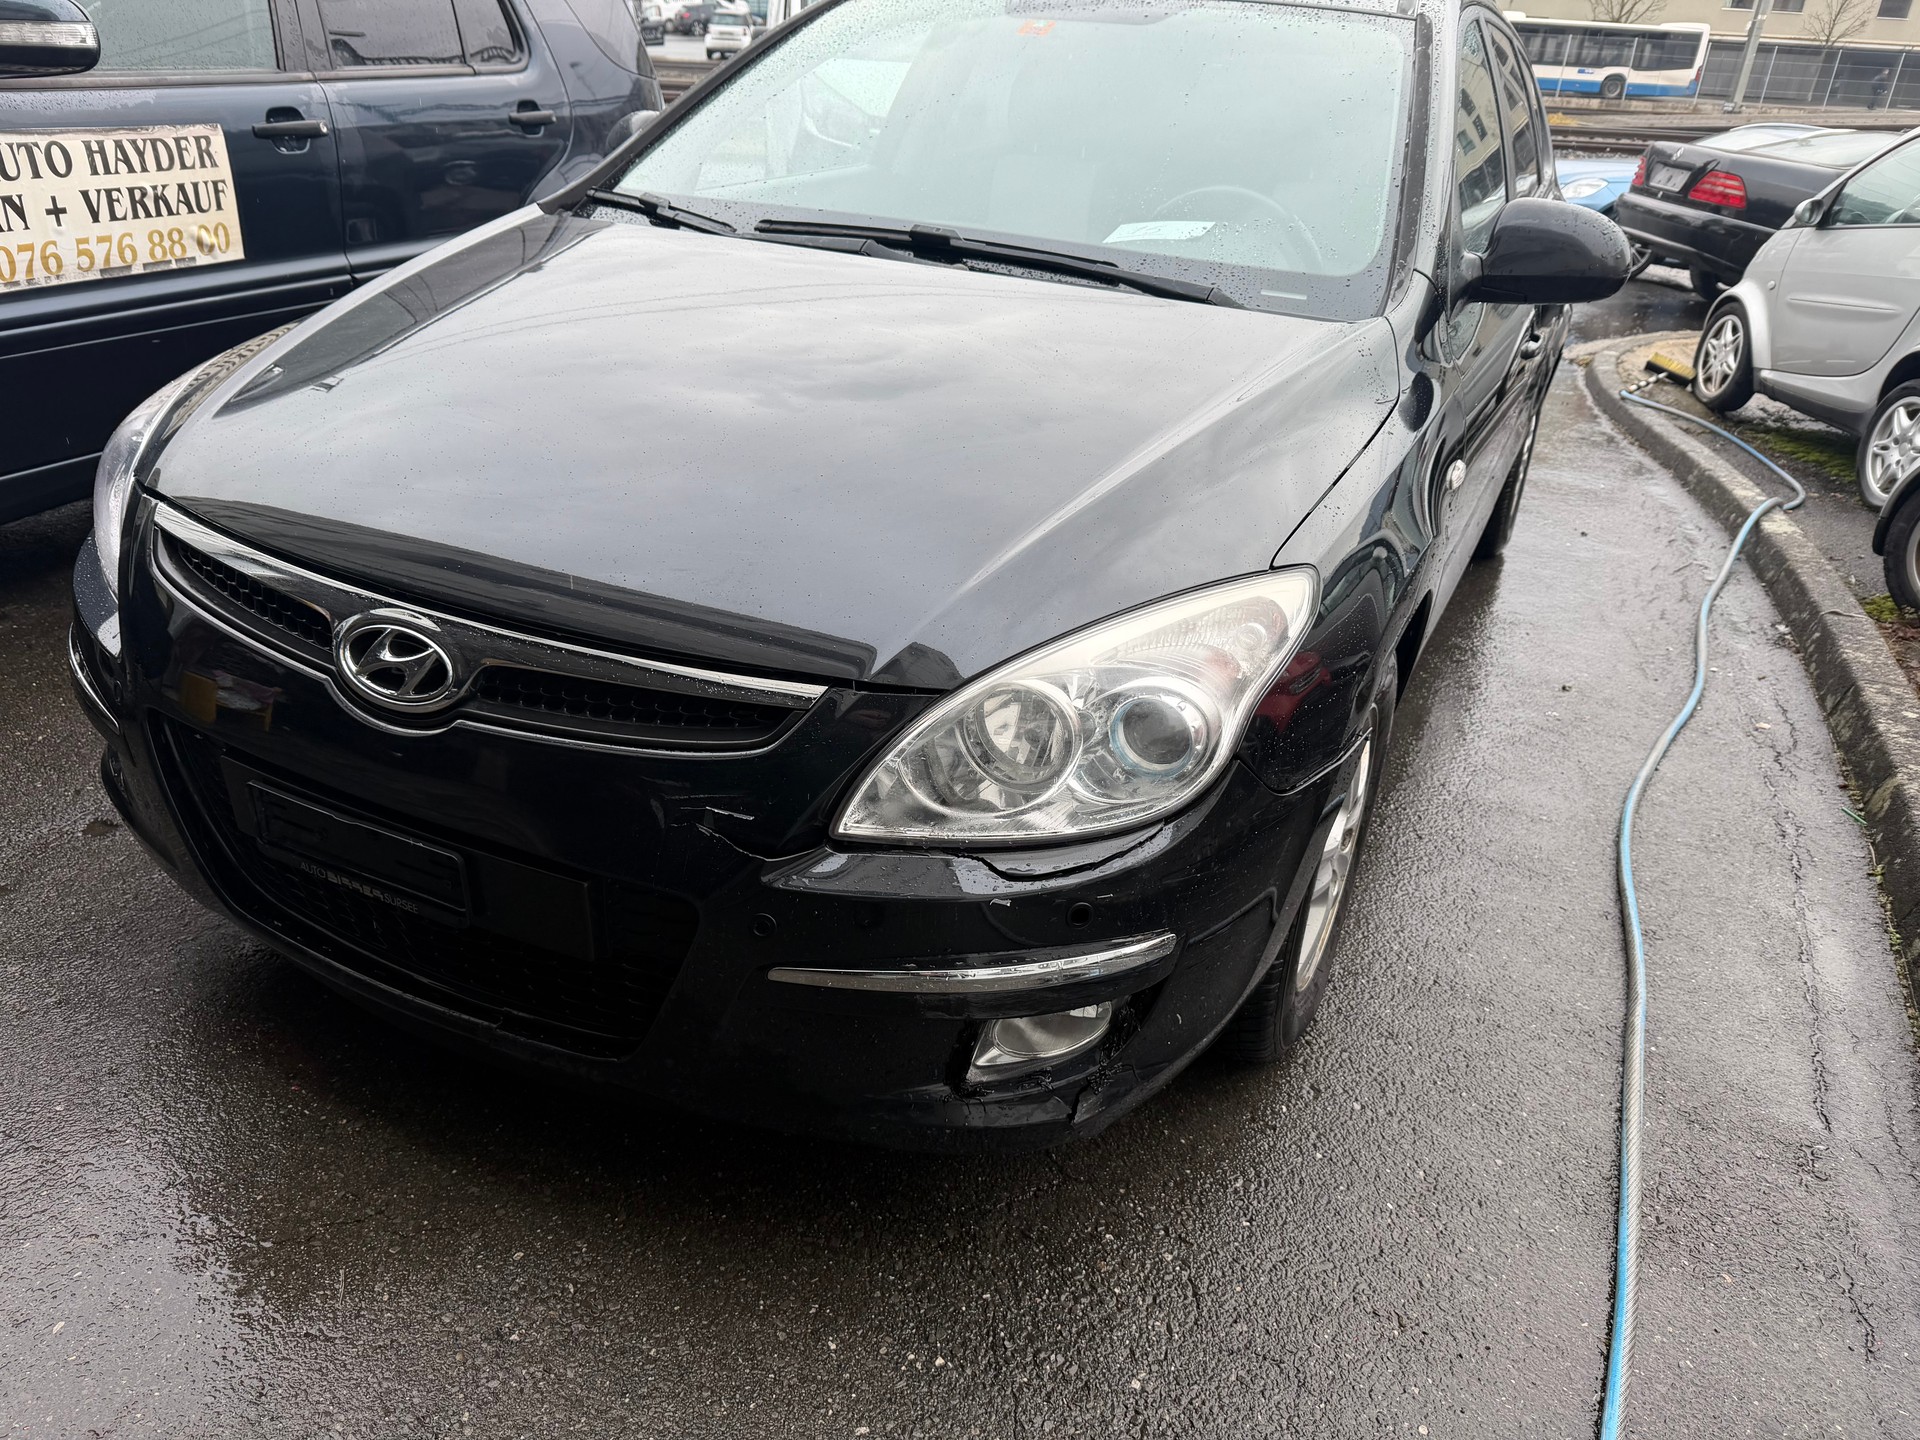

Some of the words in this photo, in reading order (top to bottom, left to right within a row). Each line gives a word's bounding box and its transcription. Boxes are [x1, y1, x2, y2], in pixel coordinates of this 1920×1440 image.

[0, 140, 73, 181] UTO
[82, 135, 219, 176] HAYDER
[45, 195, 67, 227] +
[79, 179, 228, 224] VERKAUF
[0, 240, 64, 282] 076
[75, 232, 138, 273] 576
[147, 226, 187, 263] 88
[196, 221, 231, 256] 00
[300, 862, 326, 878] AUTO
[384, 893, 419, 914] SURSEE
